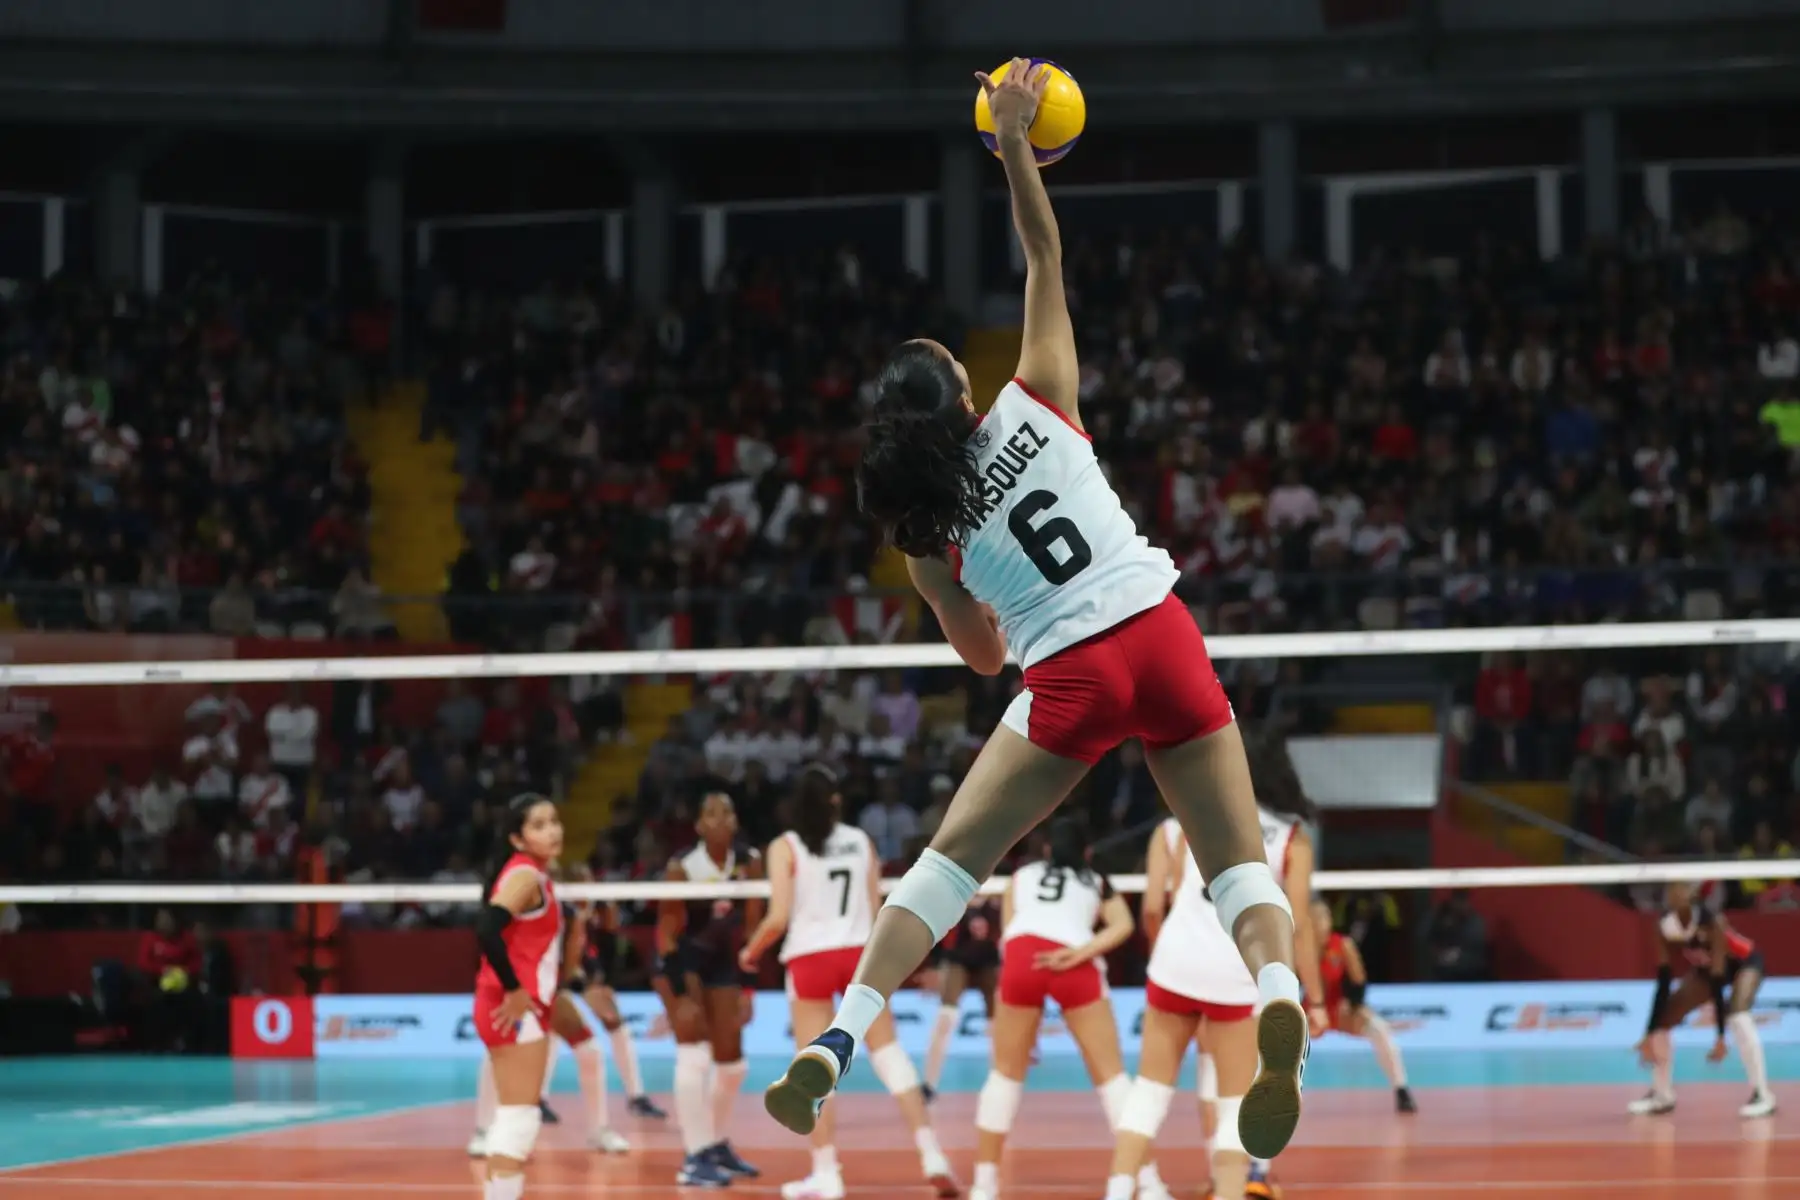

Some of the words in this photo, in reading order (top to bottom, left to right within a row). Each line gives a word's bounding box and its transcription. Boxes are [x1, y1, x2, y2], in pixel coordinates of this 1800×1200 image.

[1008, 489, 1092, 586] 6
[828, 868, 851, 917] 7
[1037, 867, 1067, 902] 9
[253, 999, 293, 1045] 0
